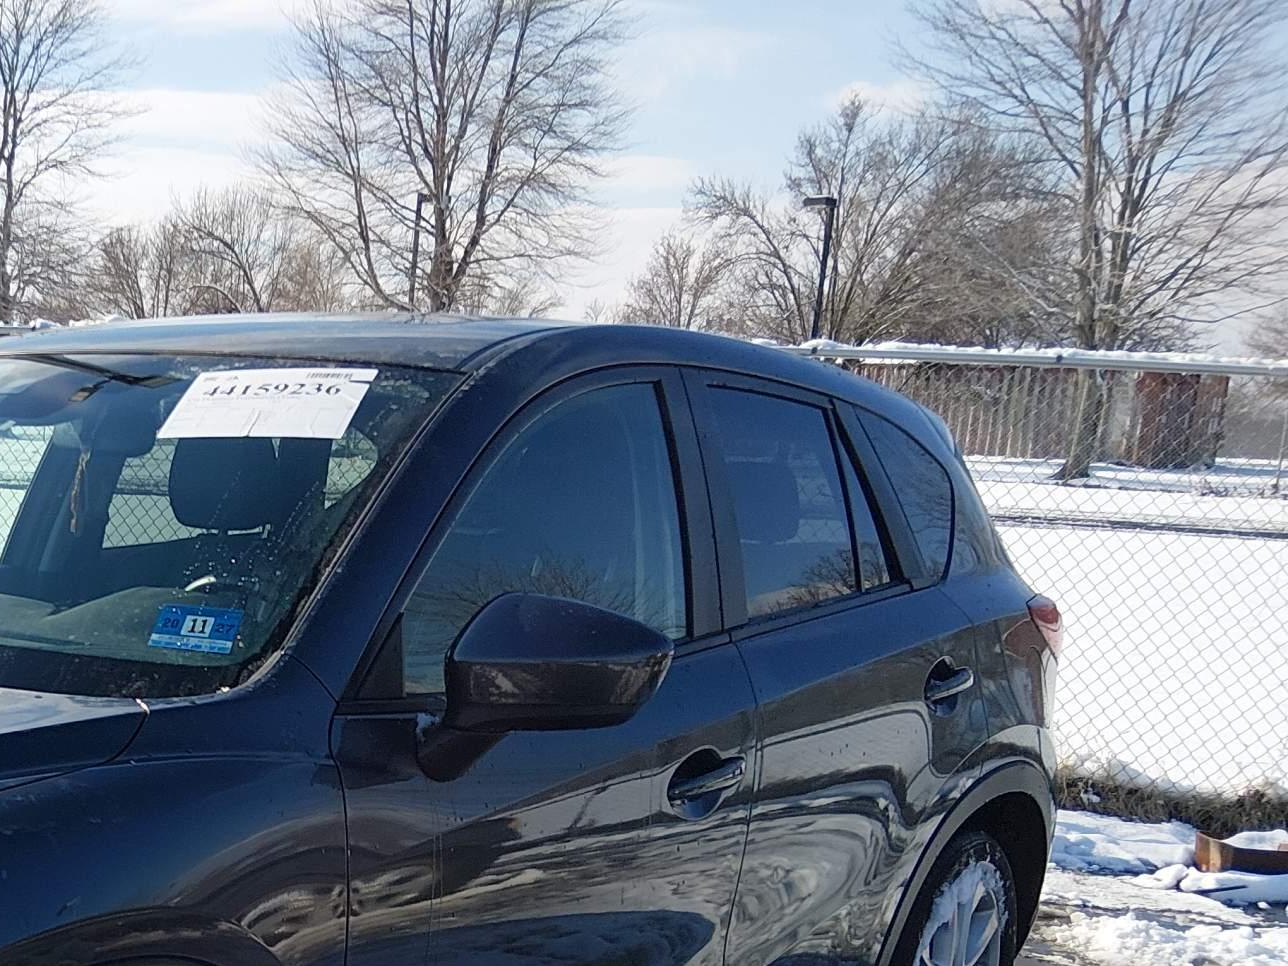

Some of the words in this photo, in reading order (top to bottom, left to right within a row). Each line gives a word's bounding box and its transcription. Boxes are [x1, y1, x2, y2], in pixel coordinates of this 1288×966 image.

[203, 383, 341, 397] 44159236
[188, 618, 208, 634] 11
[215, 623, 235, 634] 27
